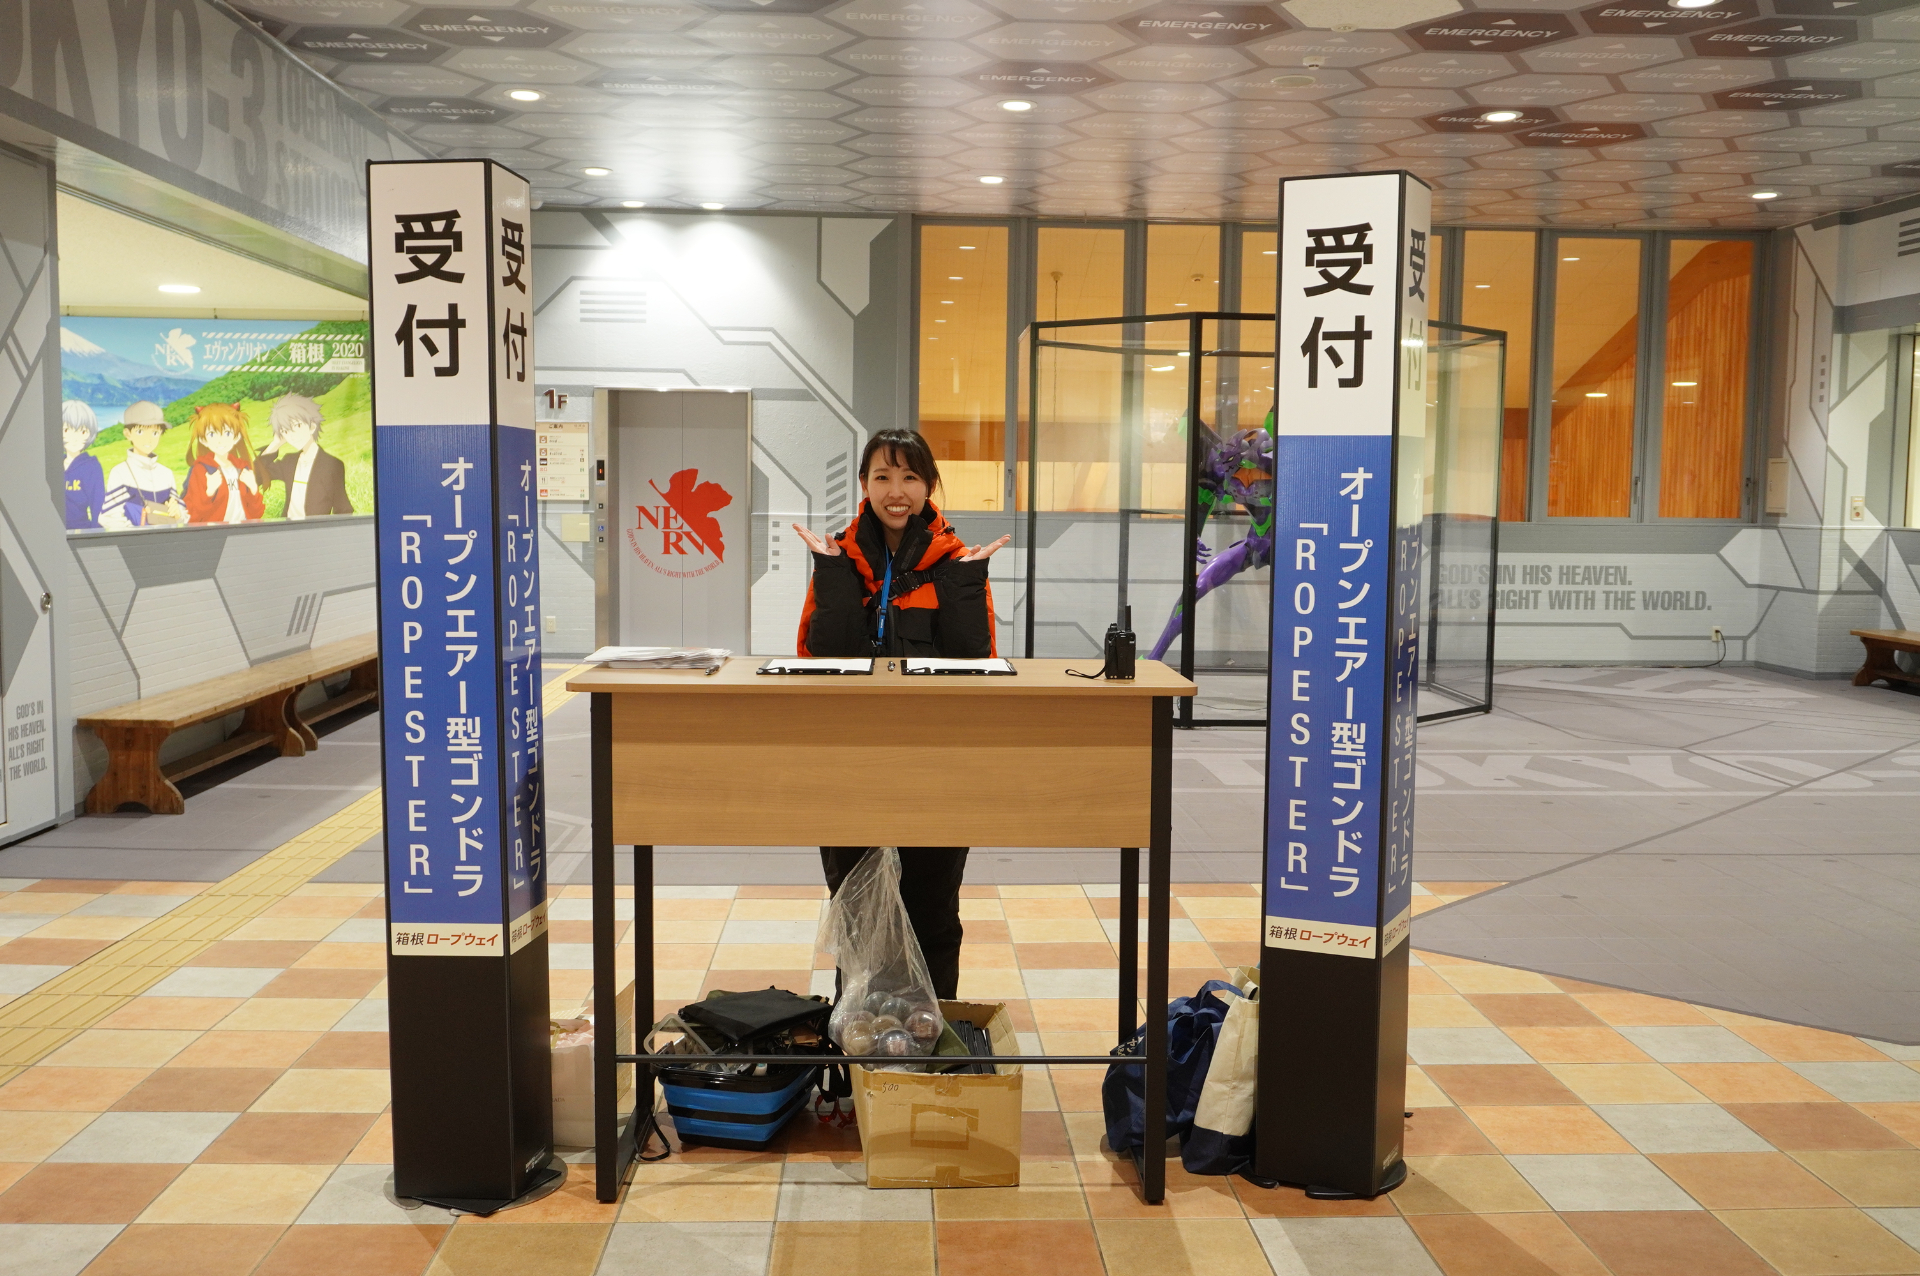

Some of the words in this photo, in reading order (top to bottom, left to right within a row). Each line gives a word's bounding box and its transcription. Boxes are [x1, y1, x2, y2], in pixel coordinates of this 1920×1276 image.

[549, 5, 684, 16] EMERGENCY
[846, 12, 981, 23] EMERGENCY
[1600, 9, 1742, 20] EMERGENCY
[420, 24, 549, 34] EMERGENCY
[1138, 20, 1273, 30] EMERGENCY
[1425, 28, 1560, 38] EMERGENCY
[303, 41, 428, 50] EMERGENCY
[1708, 34, 1844, 44] EMERGENCY
[979, 74, 1096, 82] EMERGENCY
[1728, 92, 1848, 100] EMERGENCY
[390, 107, 496, 115] EMERGENCY
[1438, 116, 1547, 124] EMERNCY
[394, 210, 466, 378] 受付
[501, 218, 527, 382] 受付
[1300, 222, 1374, 388] 受付
[1407, 228, 1426, 391] 受付
[332, 342, 364, 358] 2020
[544, 388, 568, 409] 1F
[1438, 564, 1490, 585] GOD'S
[1497, 564, 1516, 585] IN
[1522, 564, 1552, 586] HIS
[1558, 565, 1633, 586] HEAVEN.
[1548, 590, 1595, 610] WITH
[1602, 590, 1636, 610] THE
[1642, 590, 1712, 610] WORLD.
[441, 457, 484, 897] オープンエアー型ゴンドラ
[521, 459, 542, 882] オープンエアー型ゴンドラ
[1330, 467, 1373, 897] オープンエアー型ゴンドラ
[16, 702, 36, 720] GOD'S
[36, 700, 44, 714] IN
[401, 515, 433, 893] 「ROPESTER」
[1280, 523, 1328, 891] 「ROPESTER」
[8, 726, 19, 742] HIS
[20, 719, 46, 738] HEAVEN.
[8, 742, 24, 762] ALL'S
[26, 738, 45, 756] RIGHT
[9, 764, 22, 781] THE
[22, 757, 48, 777] WORLD.
